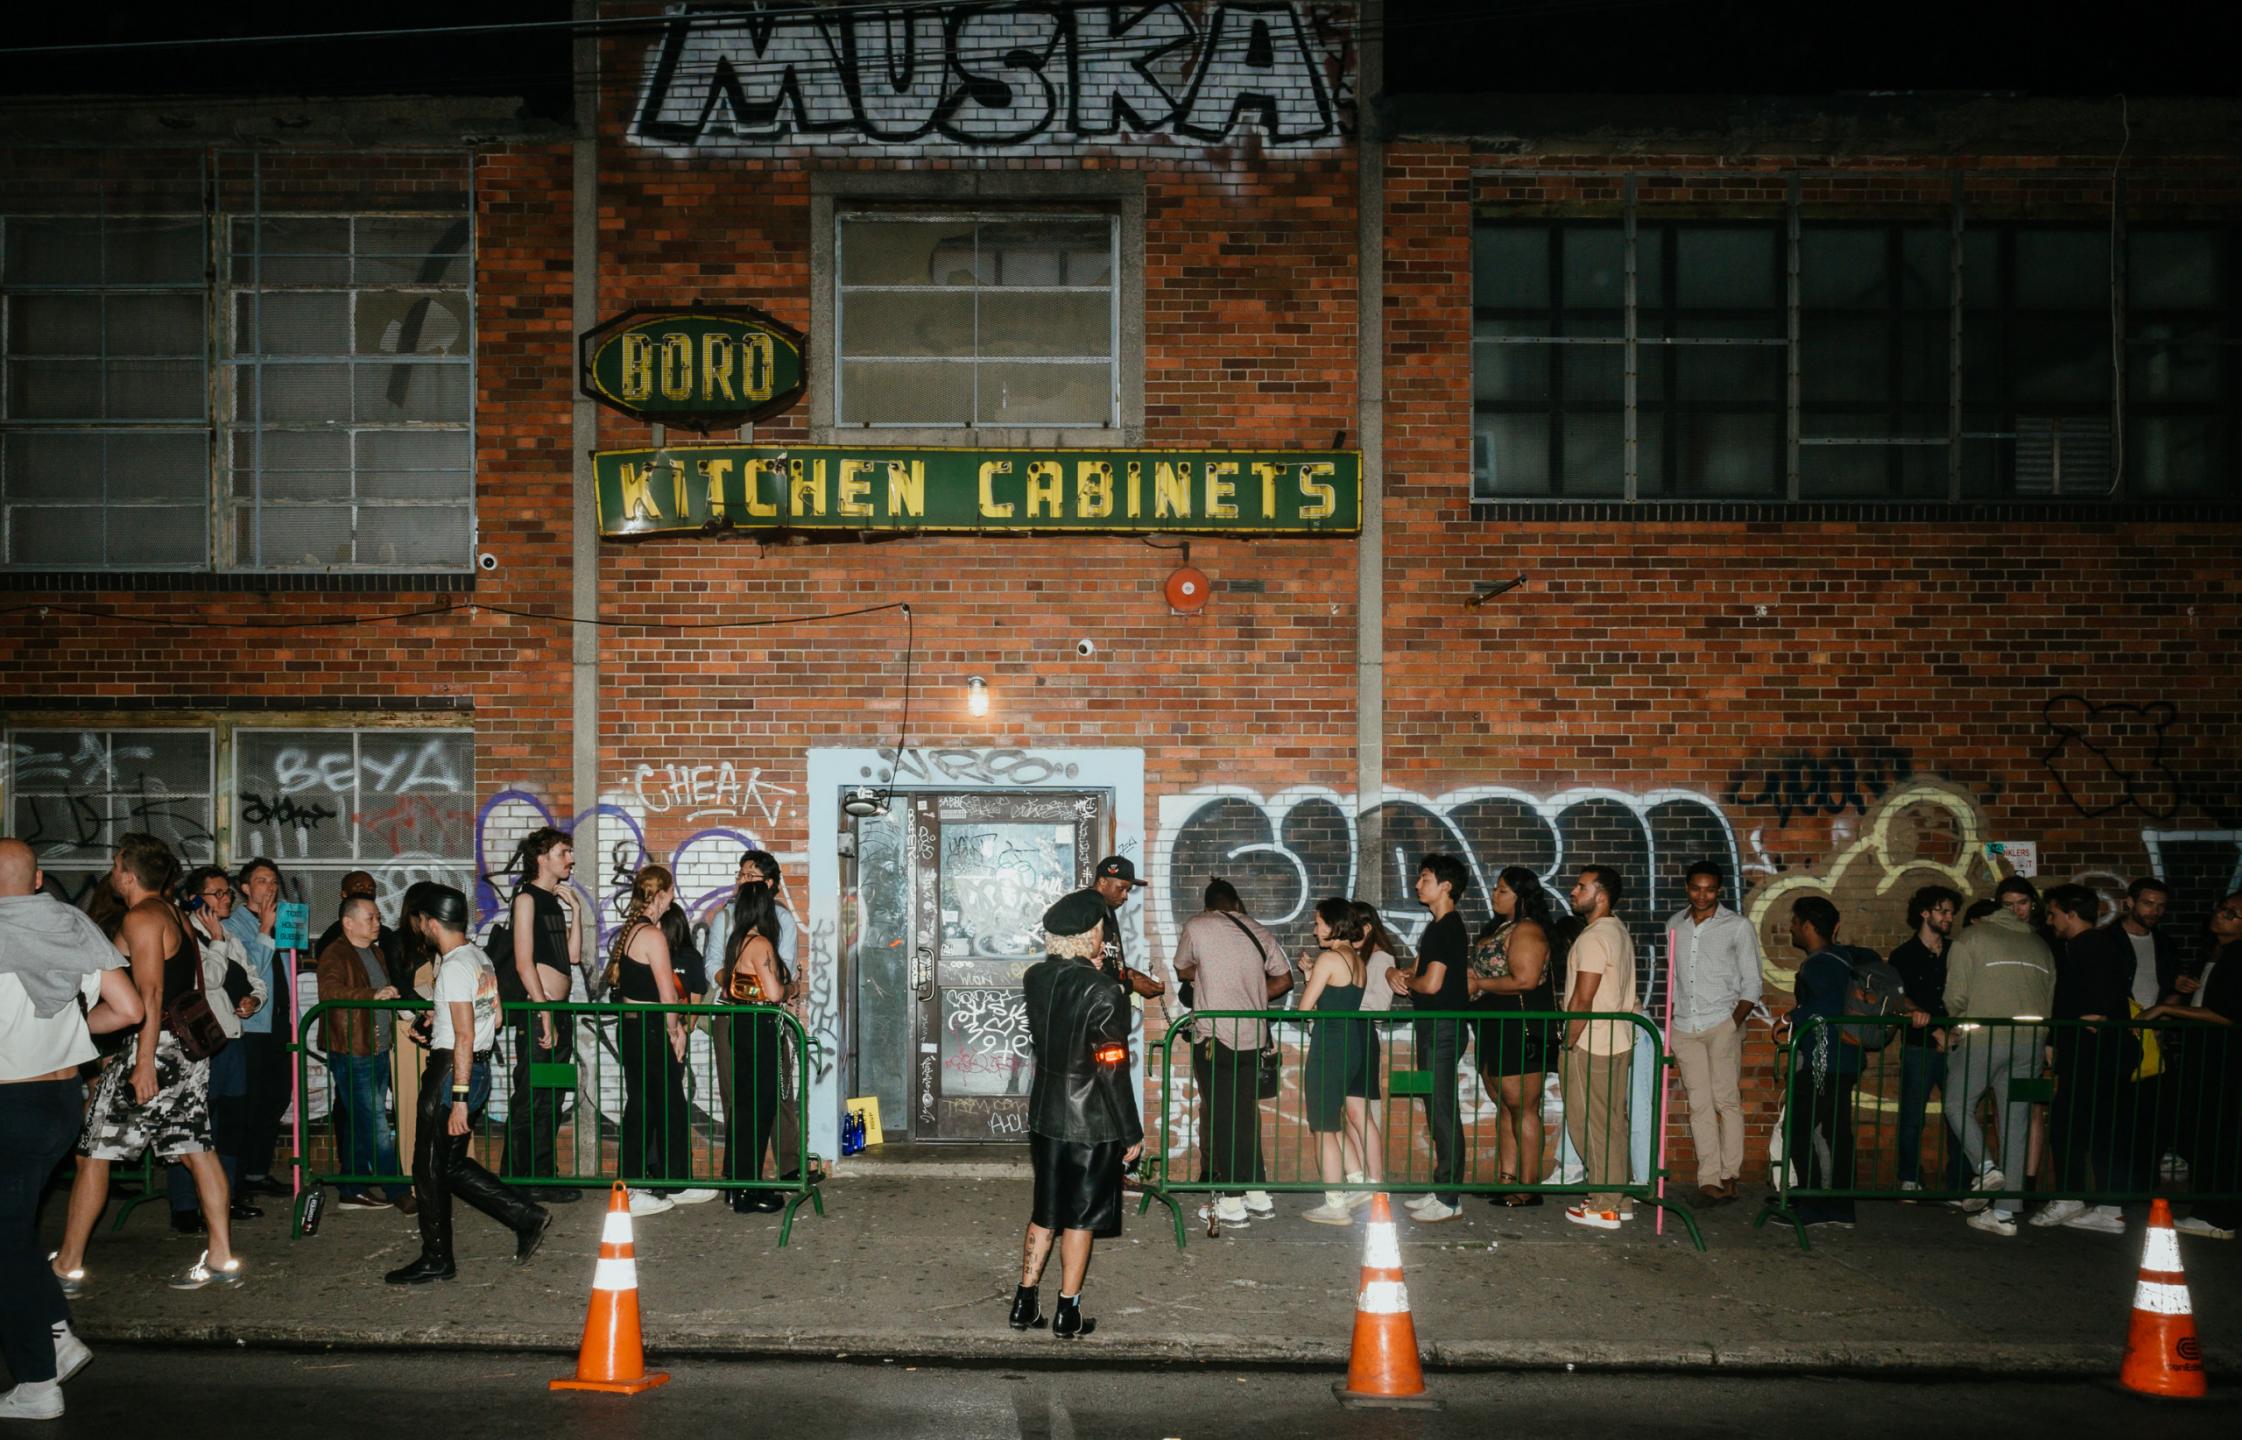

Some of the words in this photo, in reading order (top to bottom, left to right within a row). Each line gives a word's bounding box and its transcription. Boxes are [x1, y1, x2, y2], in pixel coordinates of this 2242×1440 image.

[636, 2, 1338, 144] MUSKA
[622, 333, 774, 400] BORO
[619, 459, 926, 519] KITCHEN
[978, 461, 1336, 519] CABINETS
